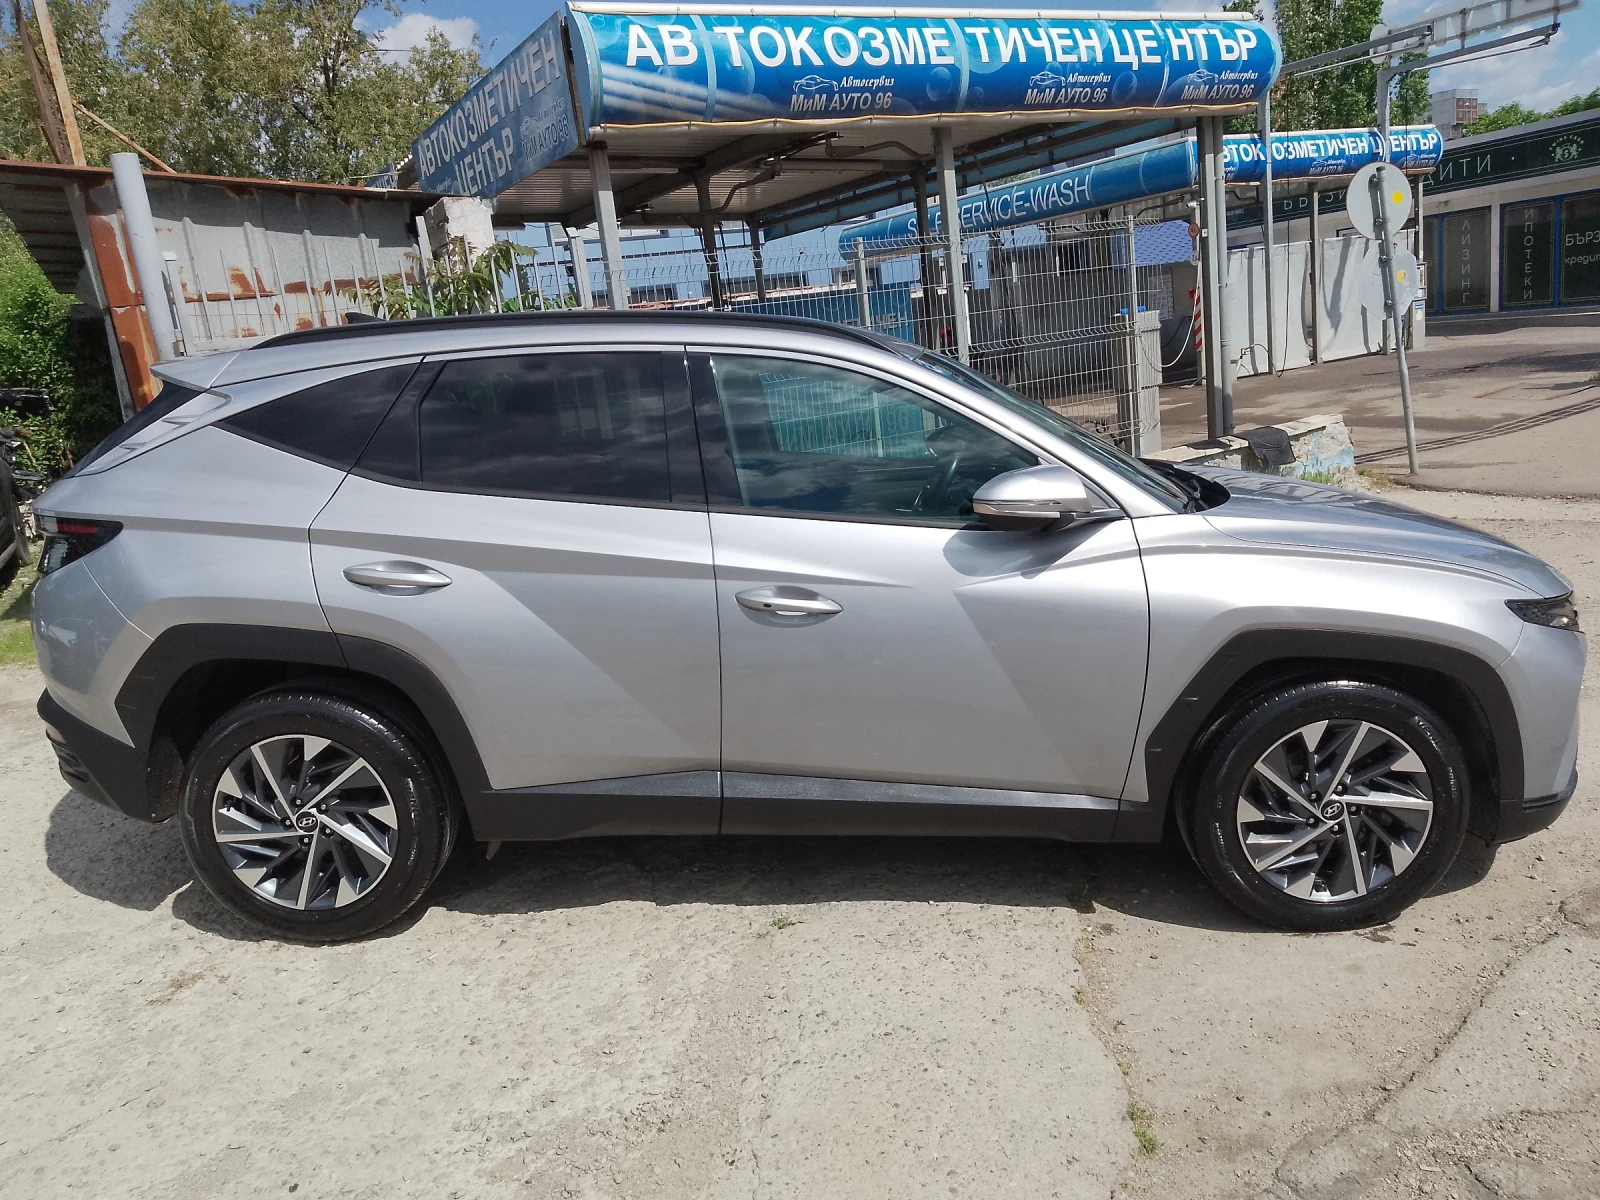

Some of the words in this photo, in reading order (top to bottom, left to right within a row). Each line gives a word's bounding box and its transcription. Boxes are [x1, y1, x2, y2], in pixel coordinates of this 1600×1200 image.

[840, 75, 895, 88] Автосервиз
[1024, 88, 1055, 105] МиМ
[1056, 87, 1092, 104] АУТО
[1092, 86, 1109, 103] 96
[1209, 84, 1241, 99] АУТО
[1241, 83, 1254, 98] 96
[417, 29, 561, 181] АВТОКОЗМЕТИЧЕН
[790, 94, 828, 112] МиМ
[828, 93, 873, 111] АУТО
[875, 91, 892, 109] 96
[558, 114, 570, 142] 96
[455, 127, 514, 196] ЦЕНТЪР
[1461, 219, 1471, 304] ЛИЗИНГ
[1523, 208, 1534, 300] ИПОТЕКИ
